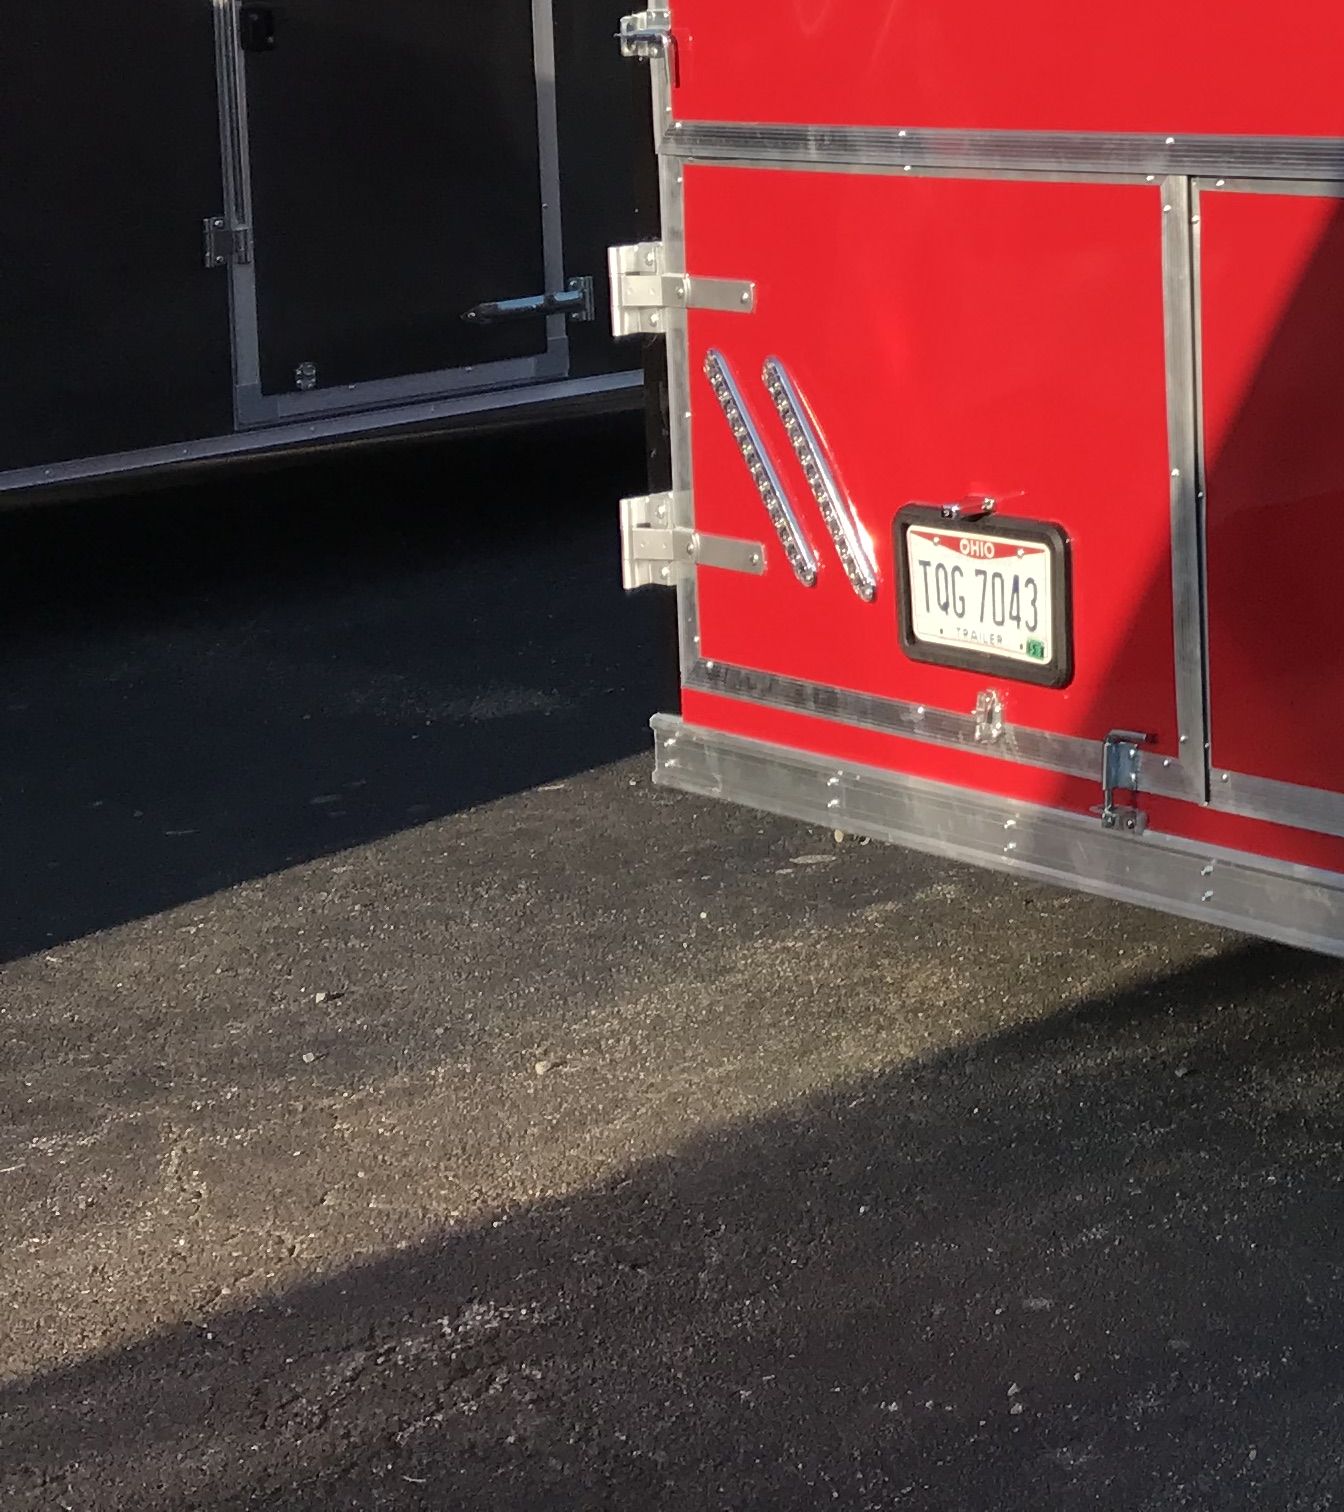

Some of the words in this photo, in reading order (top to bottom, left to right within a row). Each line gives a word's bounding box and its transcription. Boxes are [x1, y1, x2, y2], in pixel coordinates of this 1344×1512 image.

[959, 538, 995, 558] OHIO
[918, 559, 966, 619] TQG
[975, 568, 1038, 632] 7043
[956, 627, 1003, 646] TRAILER
